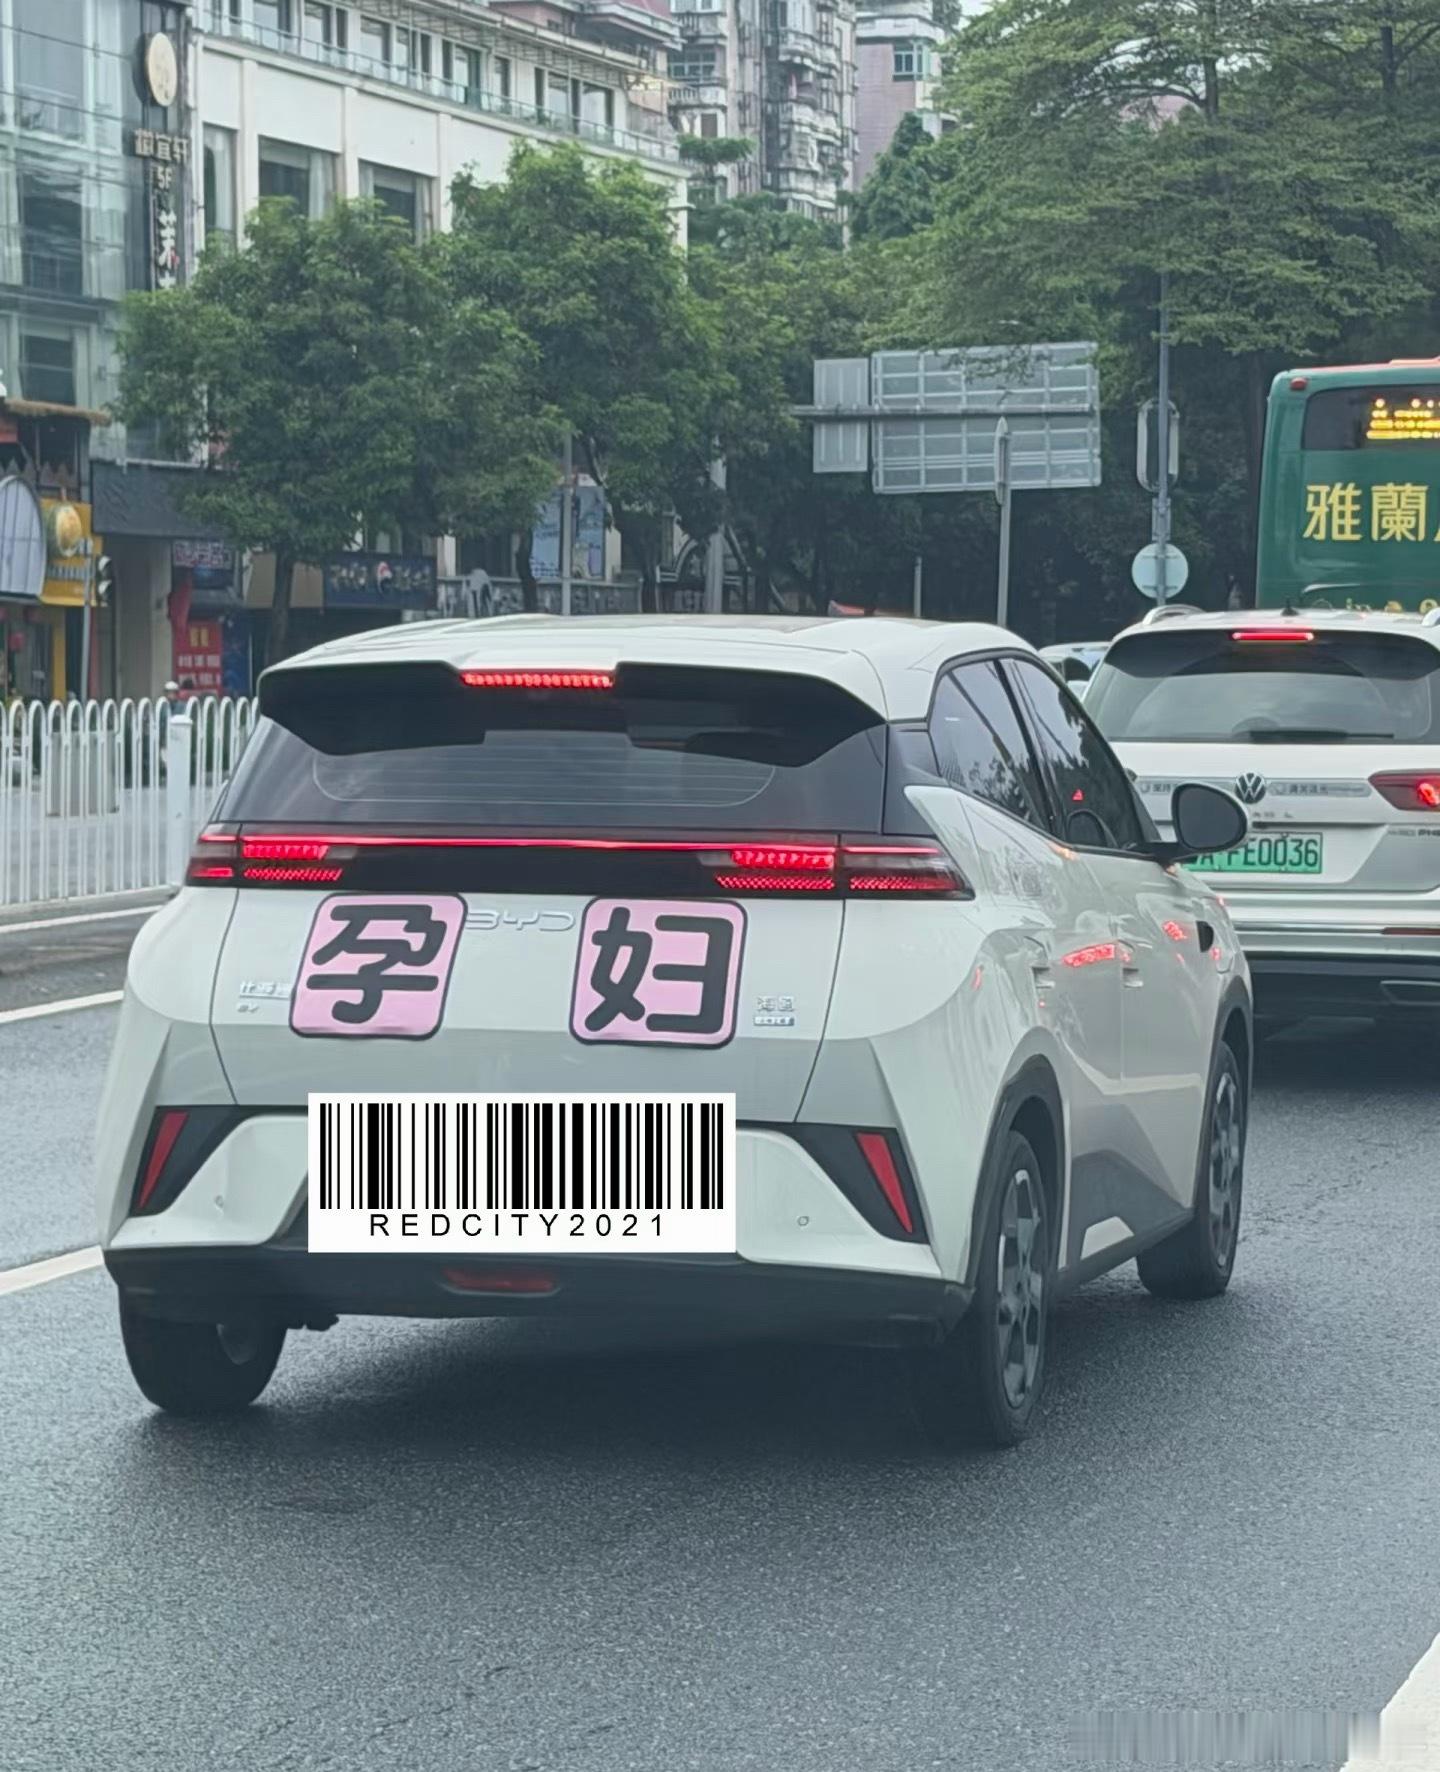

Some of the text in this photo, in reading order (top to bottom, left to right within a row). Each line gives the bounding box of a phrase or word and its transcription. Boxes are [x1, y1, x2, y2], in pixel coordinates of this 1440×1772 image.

[1302, 481, 1440, 542] 雅蘭
[466, 909, 576, 931] BYD
[306, 903, 734, 1034] 孕 妇
